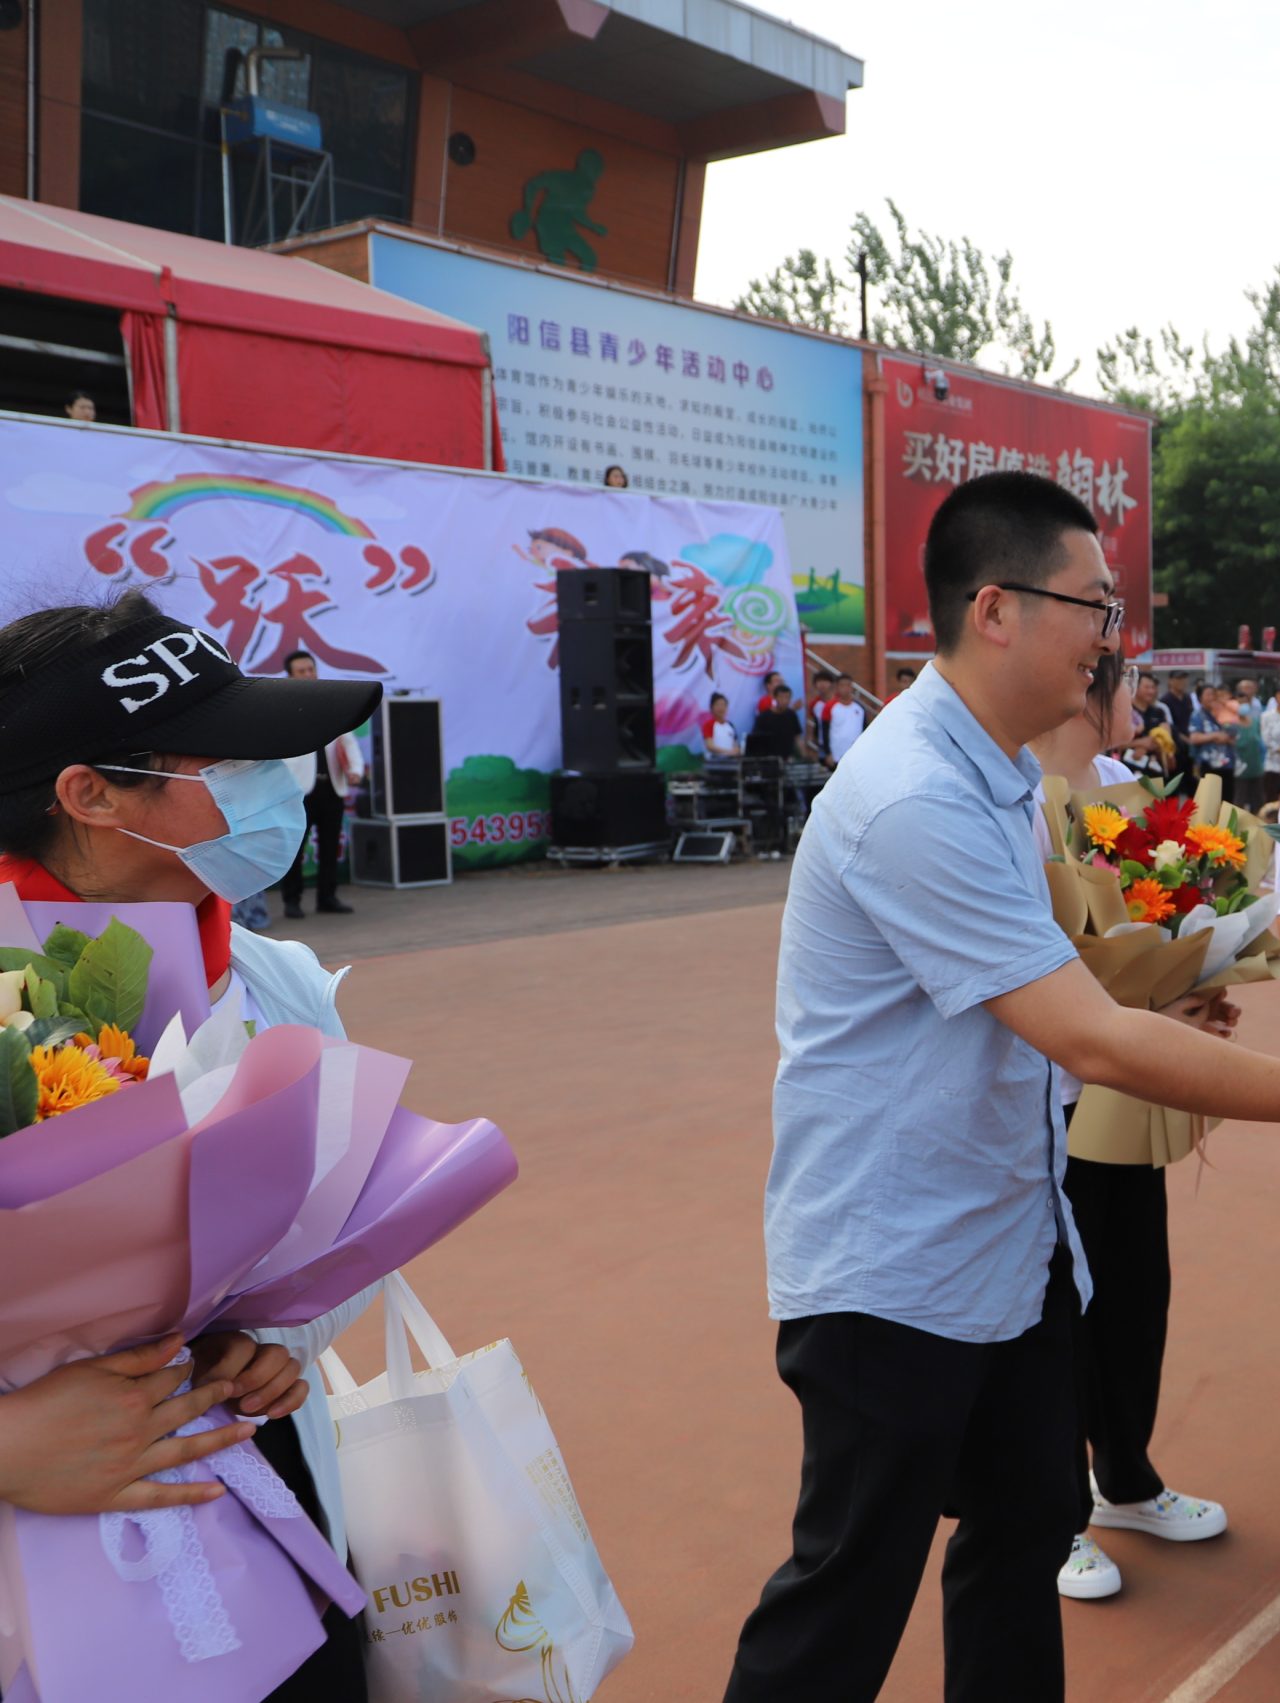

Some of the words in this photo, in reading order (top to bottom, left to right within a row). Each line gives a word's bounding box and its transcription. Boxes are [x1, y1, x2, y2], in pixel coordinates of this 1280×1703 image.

[506, 313, 775, 393] 阳信县青少年活动中心
[101, 628, 237, 714] SPO
[373, 1570, 461, 1613] FUSHI
